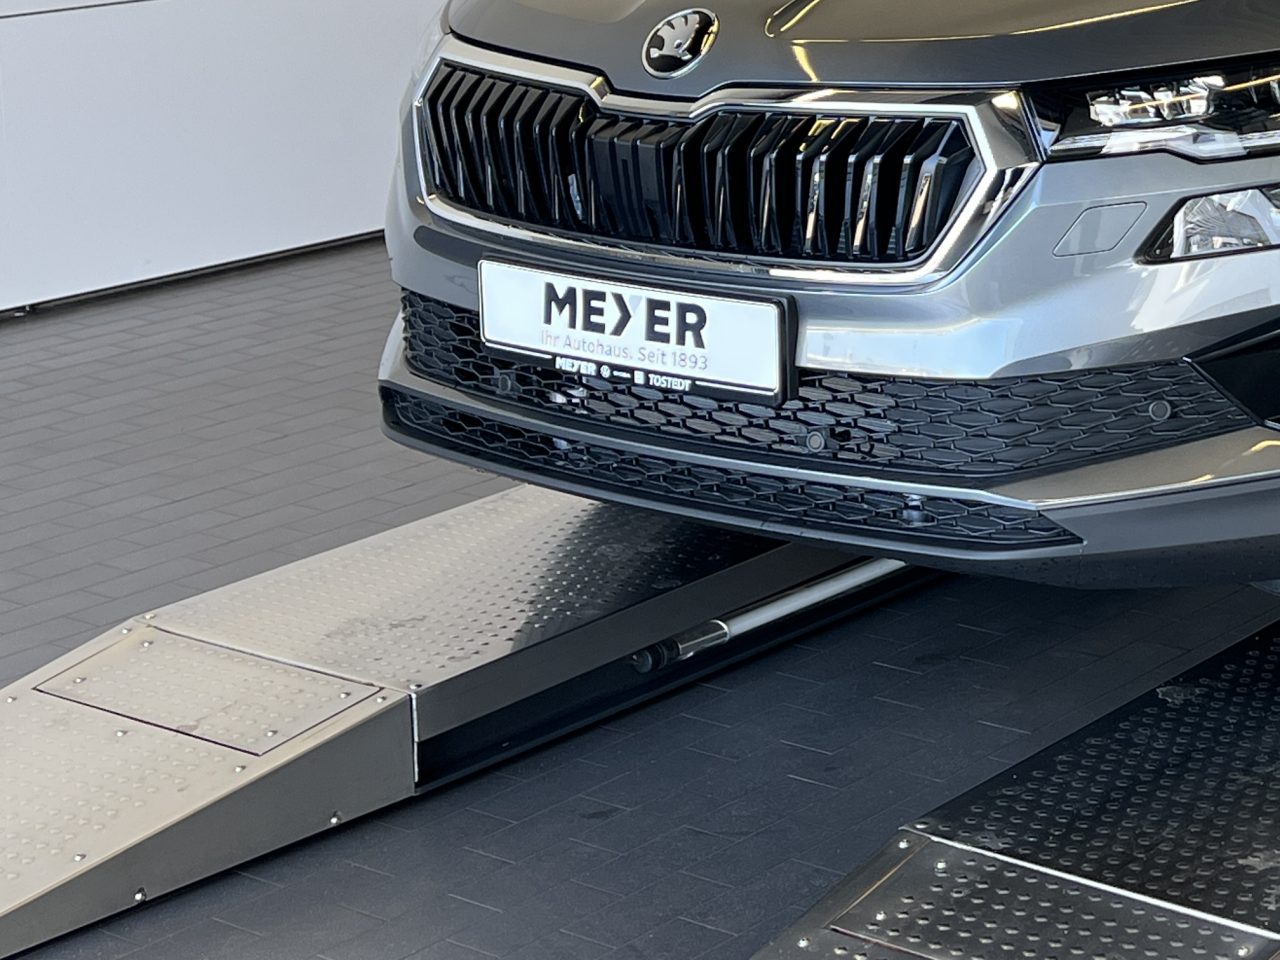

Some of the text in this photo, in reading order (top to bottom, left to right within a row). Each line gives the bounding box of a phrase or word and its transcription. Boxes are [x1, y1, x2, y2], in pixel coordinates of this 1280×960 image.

[543, 281, 708, 349] MEYER
[541, 329, 709, 371] Ihr Autohaus. Seit 1893
[555, 356, 597, 376] MEYER
[648, 373, 692, 391] TOSTEDT
